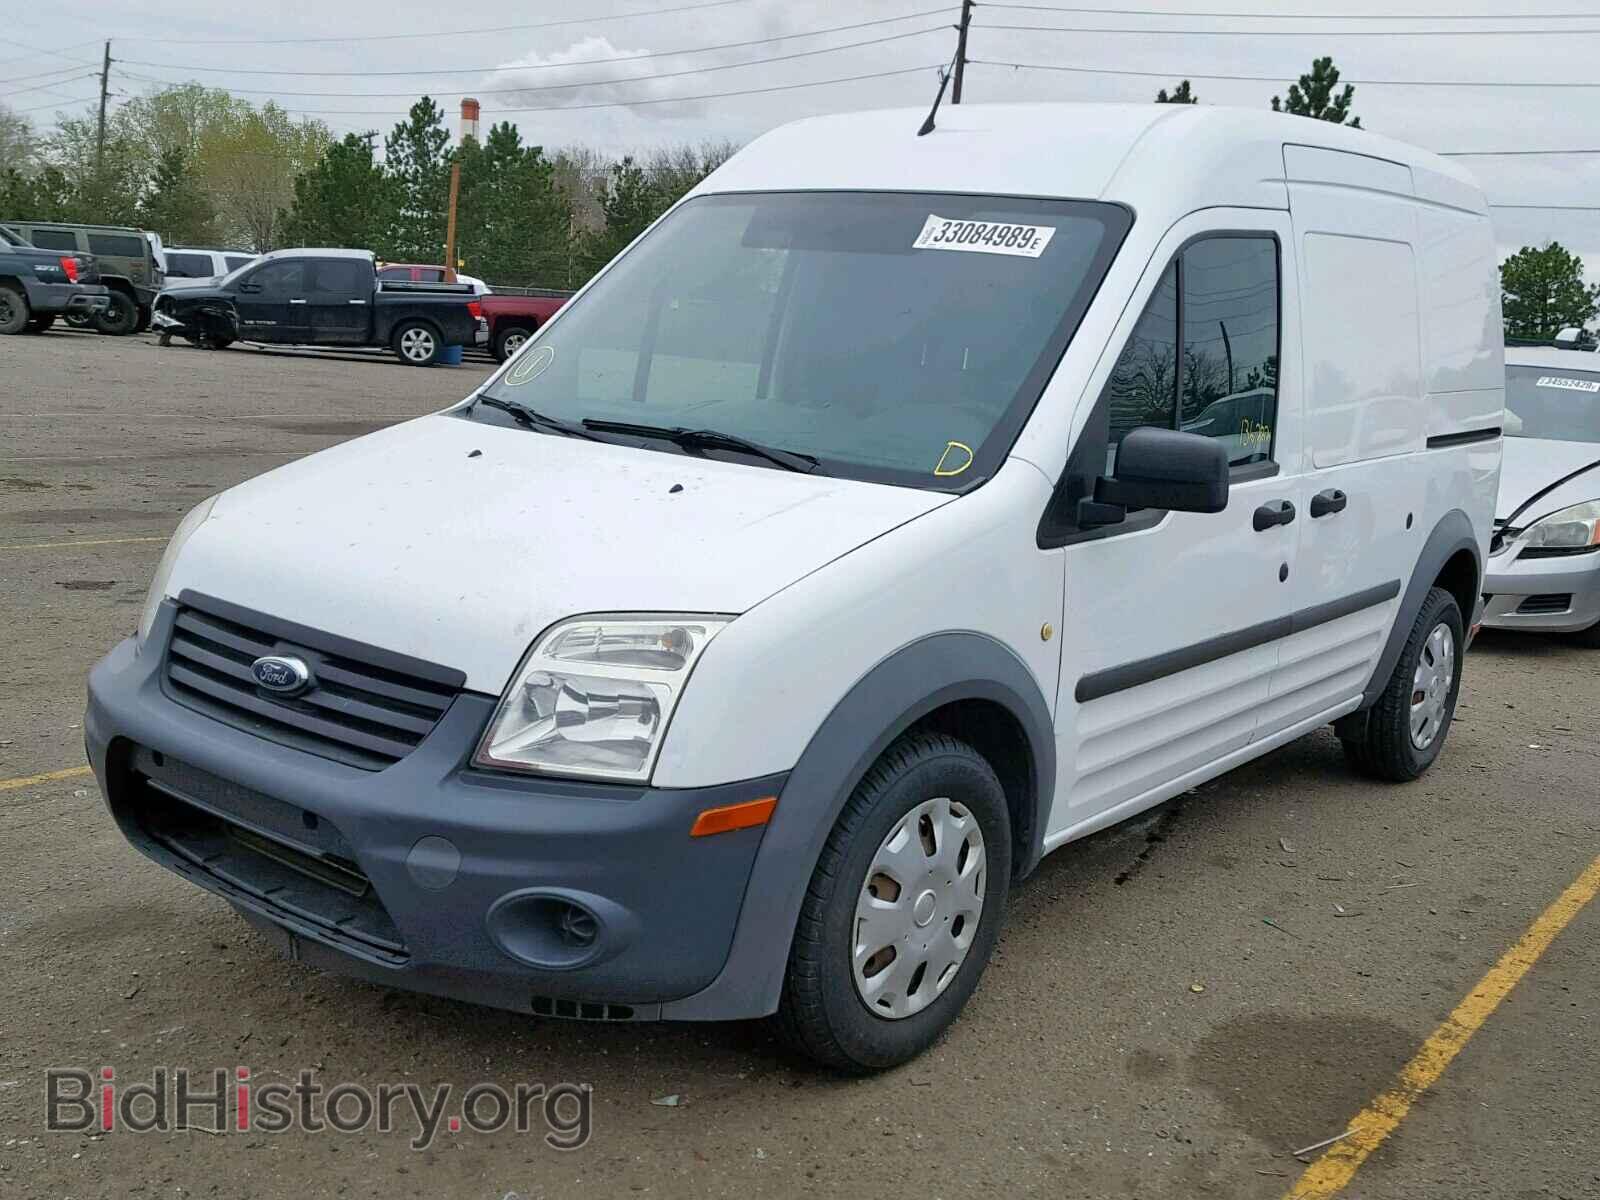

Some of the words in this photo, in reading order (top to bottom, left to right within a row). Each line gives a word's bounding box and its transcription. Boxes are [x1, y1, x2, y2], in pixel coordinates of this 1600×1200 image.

[933, 221, 1036, 249] 33084989
[1030, 238, 1042, 250] E
[933, 441, 974, 476] D
[259, 662, 289, 685] Ford
